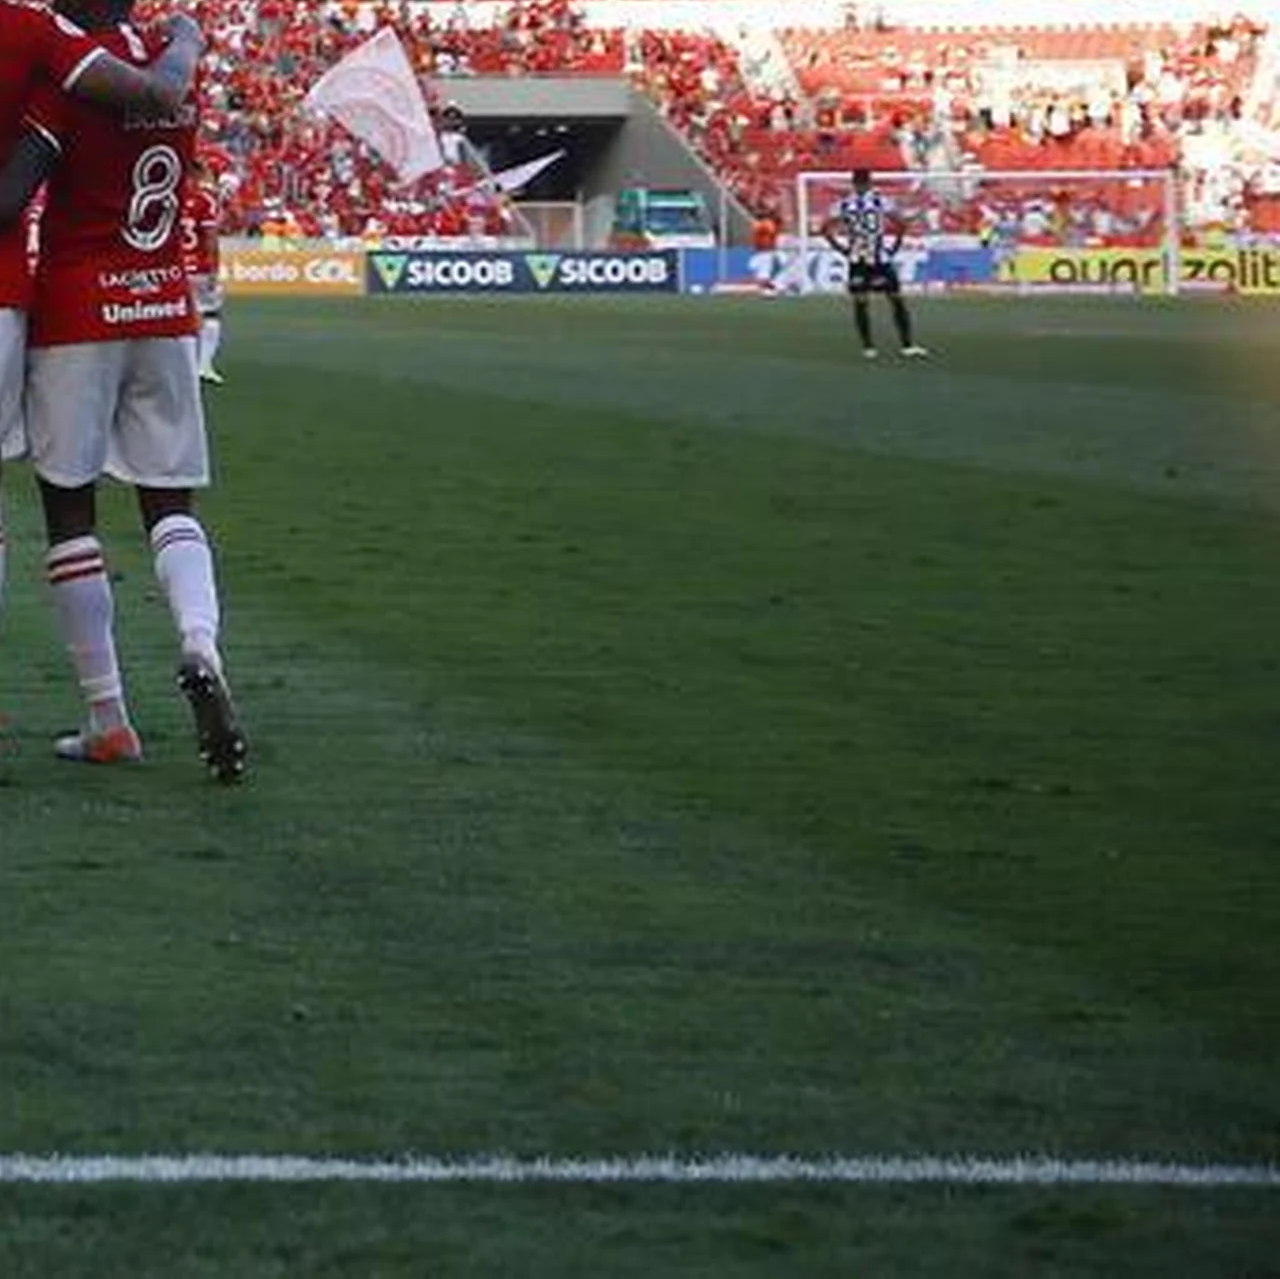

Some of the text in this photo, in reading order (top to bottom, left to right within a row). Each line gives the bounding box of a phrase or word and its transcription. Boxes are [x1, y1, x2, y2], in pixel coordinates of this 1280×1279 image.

[122, 145, 181, 251] 8
[407, 259, 514, 285] SICOOB
[559, 258, 668, 284] SICOOB
[103, 298, 188, 323] Unimed
